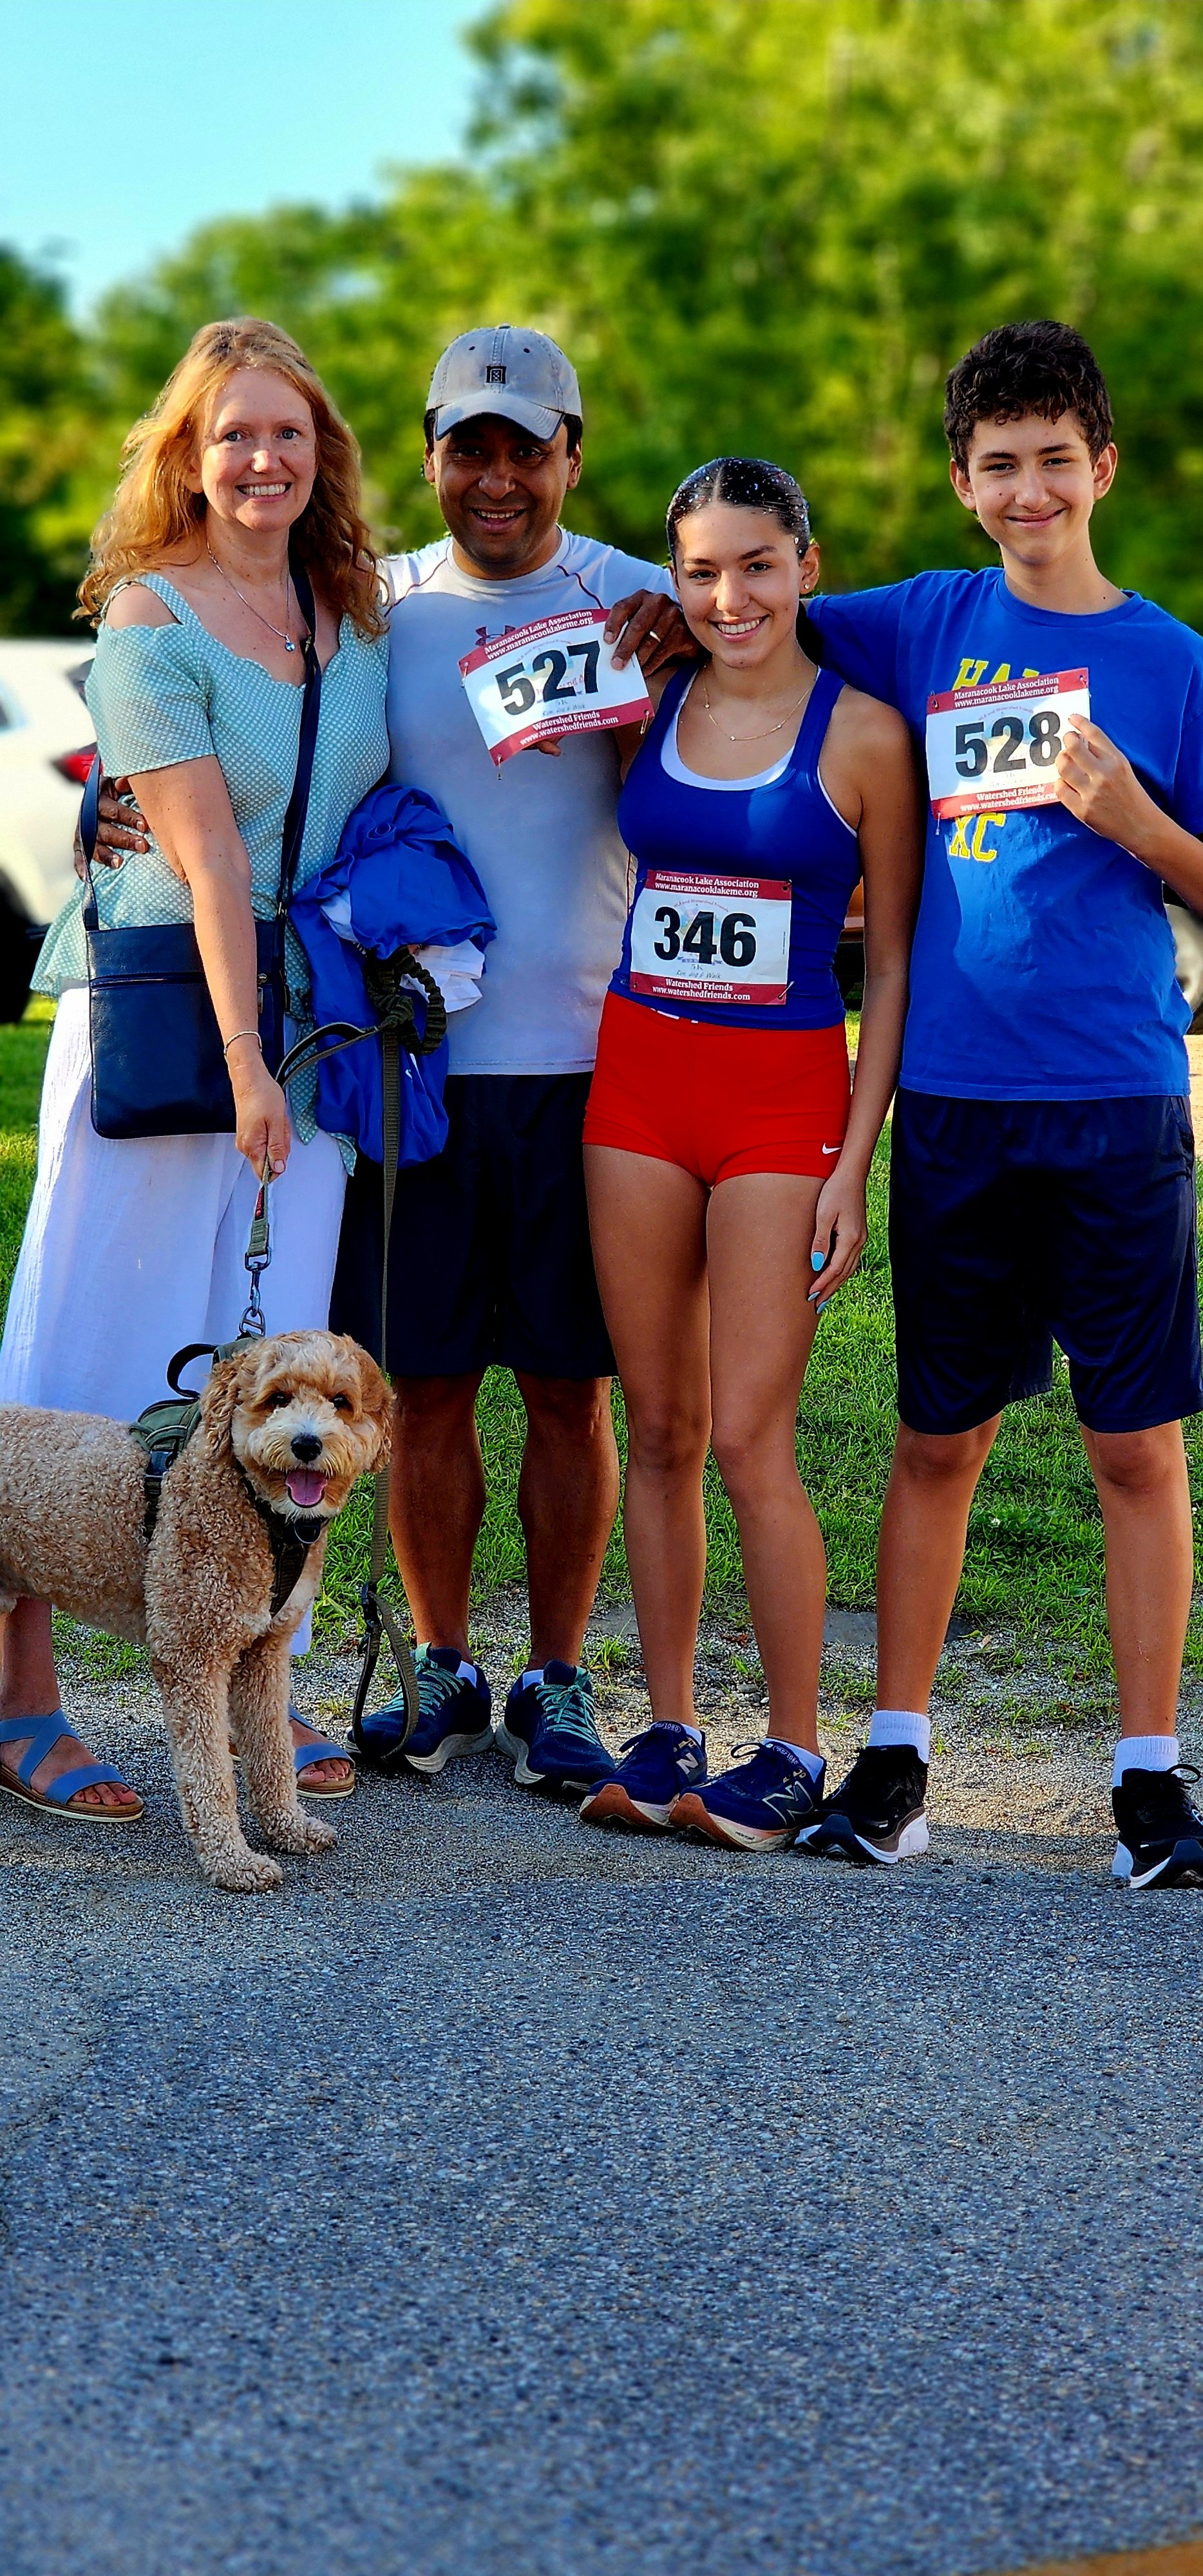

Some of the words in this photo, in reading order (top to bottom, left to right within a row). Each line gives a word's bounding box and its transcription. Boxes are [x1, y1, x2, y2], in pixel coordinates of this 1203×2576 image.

[485, 628, 529, 654] Maranacook
[528, 621, 547, 634] Lake
[548, 611, 592, 627] Association
[487, 617, 594, 660] www.maranacooklakeme.org
[495, 640, 600, 715] 527
[954, 687, 998, 700] Maranacook
[999, 683, 1016, 692] Lake
[1017, 677, 1059, 690] Association
[954, 685, 1059, 708] www.maranacooklakeme.org
[520, 716, 618, 746] www.watershedfriends.com
[533, 715, 573, 731] Watershed
[574, 711, 600, 721] Friends
[955, 711, 1061, 777] 528
[976, 789, 1017, 801] Watershed
[1018, 784, 1045, 796] Friends
[949, 812, 1006, 862] XC
[655, 883, 758, 898] www.maranacooklakeme.org
[656, 873, 694, 884] Maranacook
[696, 876, 712, 886] Lake
[714, 878, 759, 889] Association
[654, 906, 756, 967] 346
[652, 987, 750, 1000] www.watershedfriends.com
[665, 978, 702, 989] Watershed
[703, 982, 733, 992] Friends
